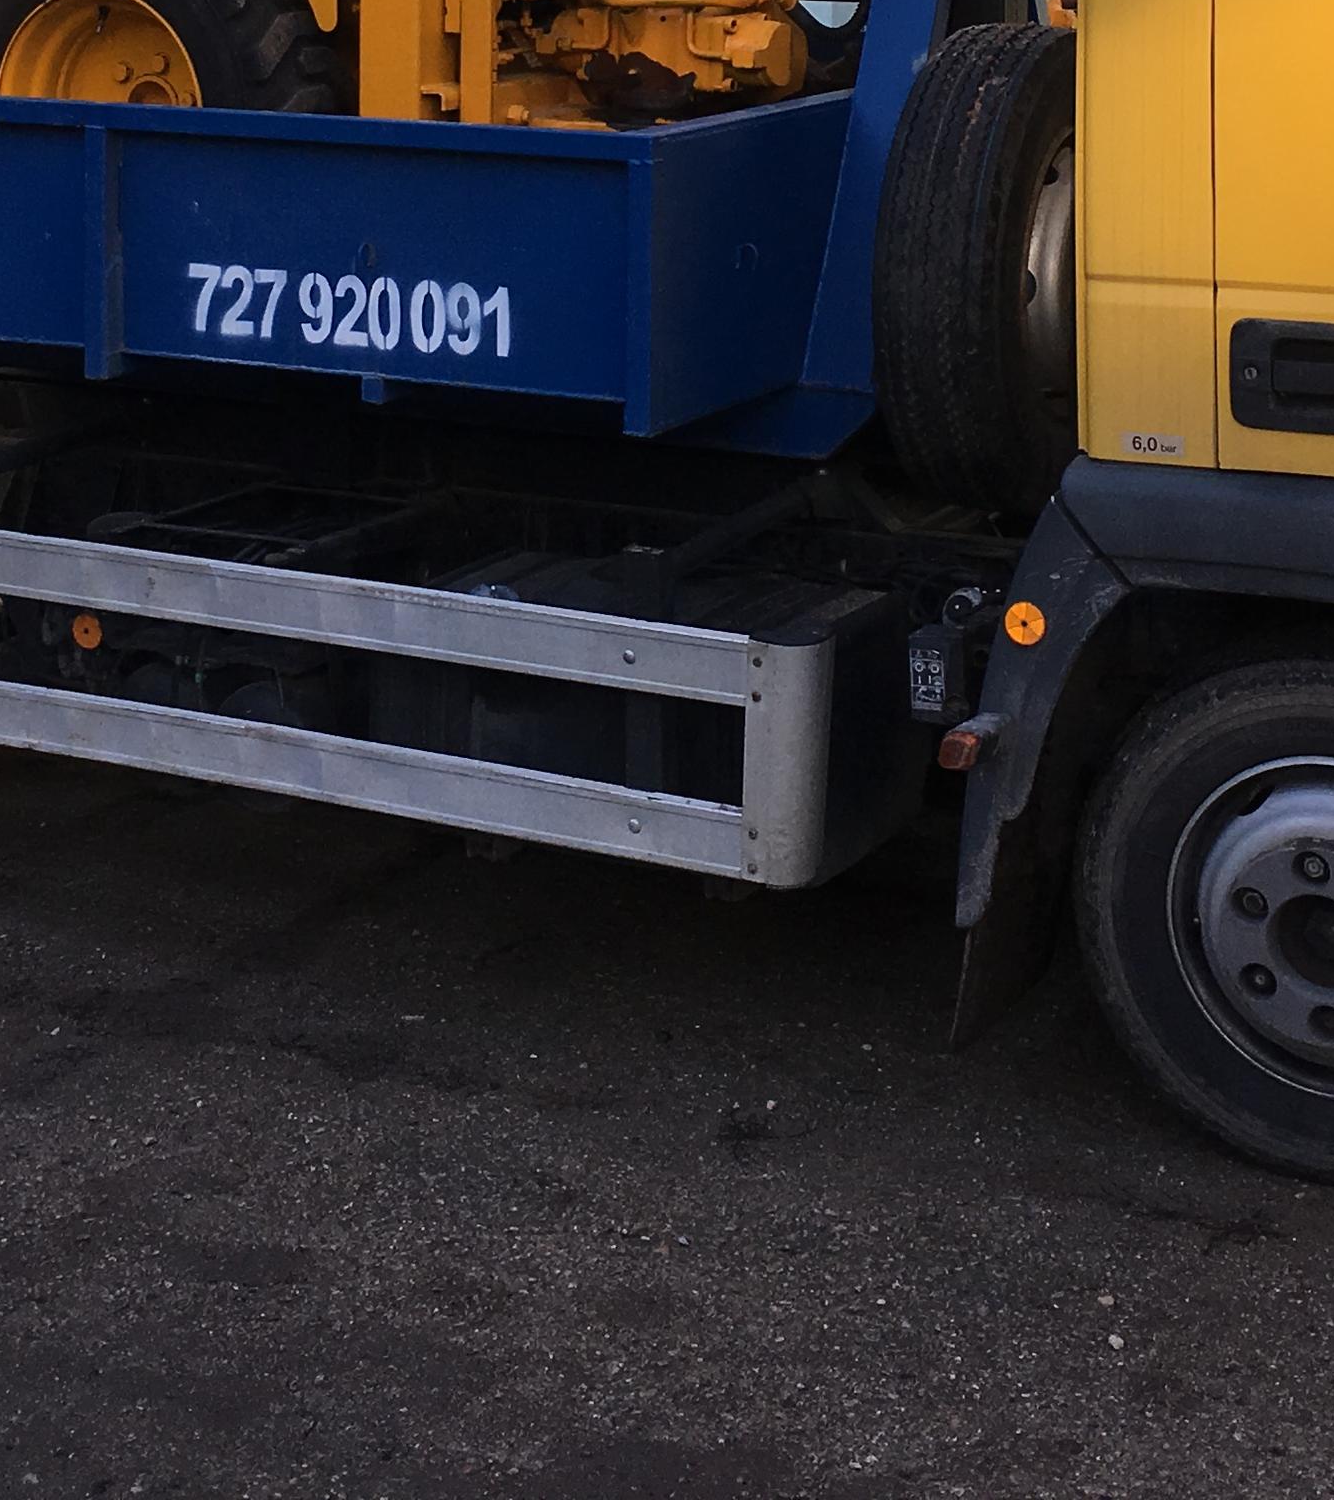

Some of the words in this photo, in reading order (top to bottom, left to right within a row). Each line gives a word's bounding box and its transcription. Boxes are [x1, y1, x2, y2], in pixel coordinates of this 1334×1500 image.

[188, 262, 287, 338] 727
[299, 271, 401, 350] 920
[410, 279, 511, 357] 091
[1132, 435, 1158, 453] 6,0
[1160, 444, 1177, 453] bar
